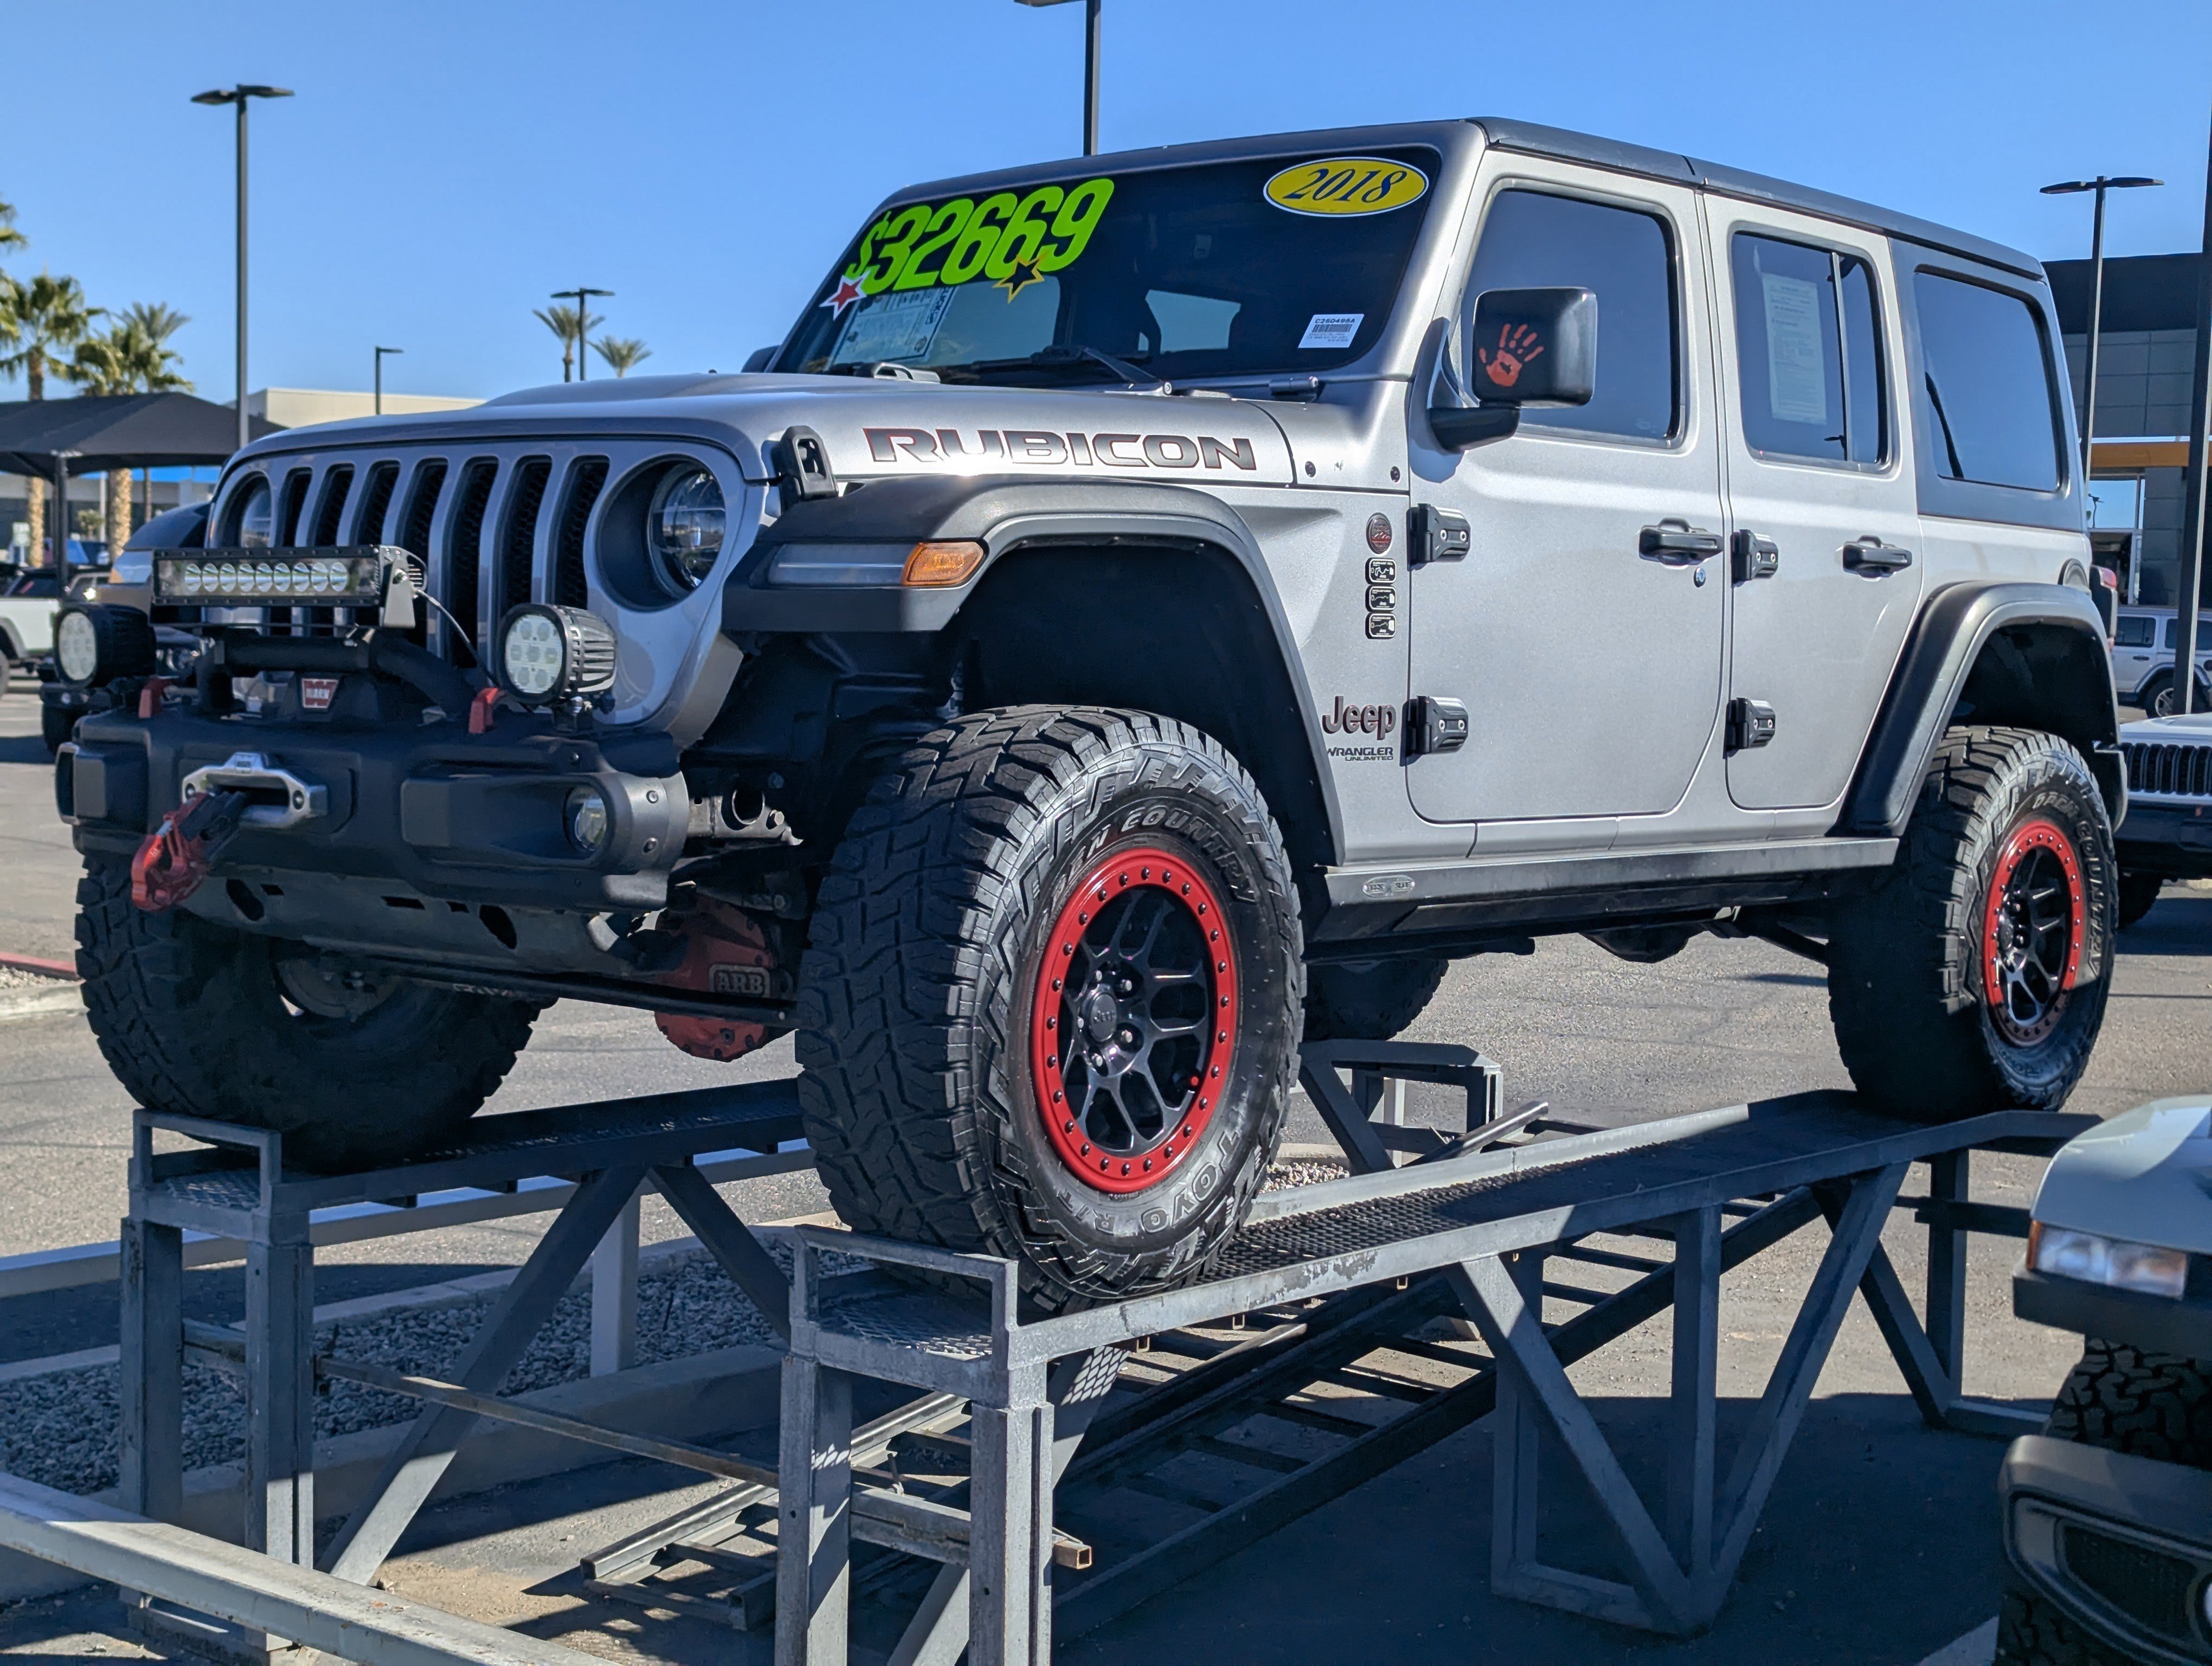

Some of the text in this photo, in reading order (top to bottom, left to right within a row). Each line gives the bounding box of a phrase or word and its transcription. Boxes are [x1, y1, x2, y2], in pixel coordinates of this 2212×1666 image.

[1282, 168, 1408, 203] 2018
[845, 178, 1115, 295] $32669
[862, 428, 1257, 470] RUBICON
[1322, 695, 1397, 741] Jeep
[1327, 747, 1393, 757] WRANGLER
[1120, 804, 1257, 904] COUNTRY
[717, 971, 764, 995] ARB
[1141, 1131, 1242, 1234] TOYO
